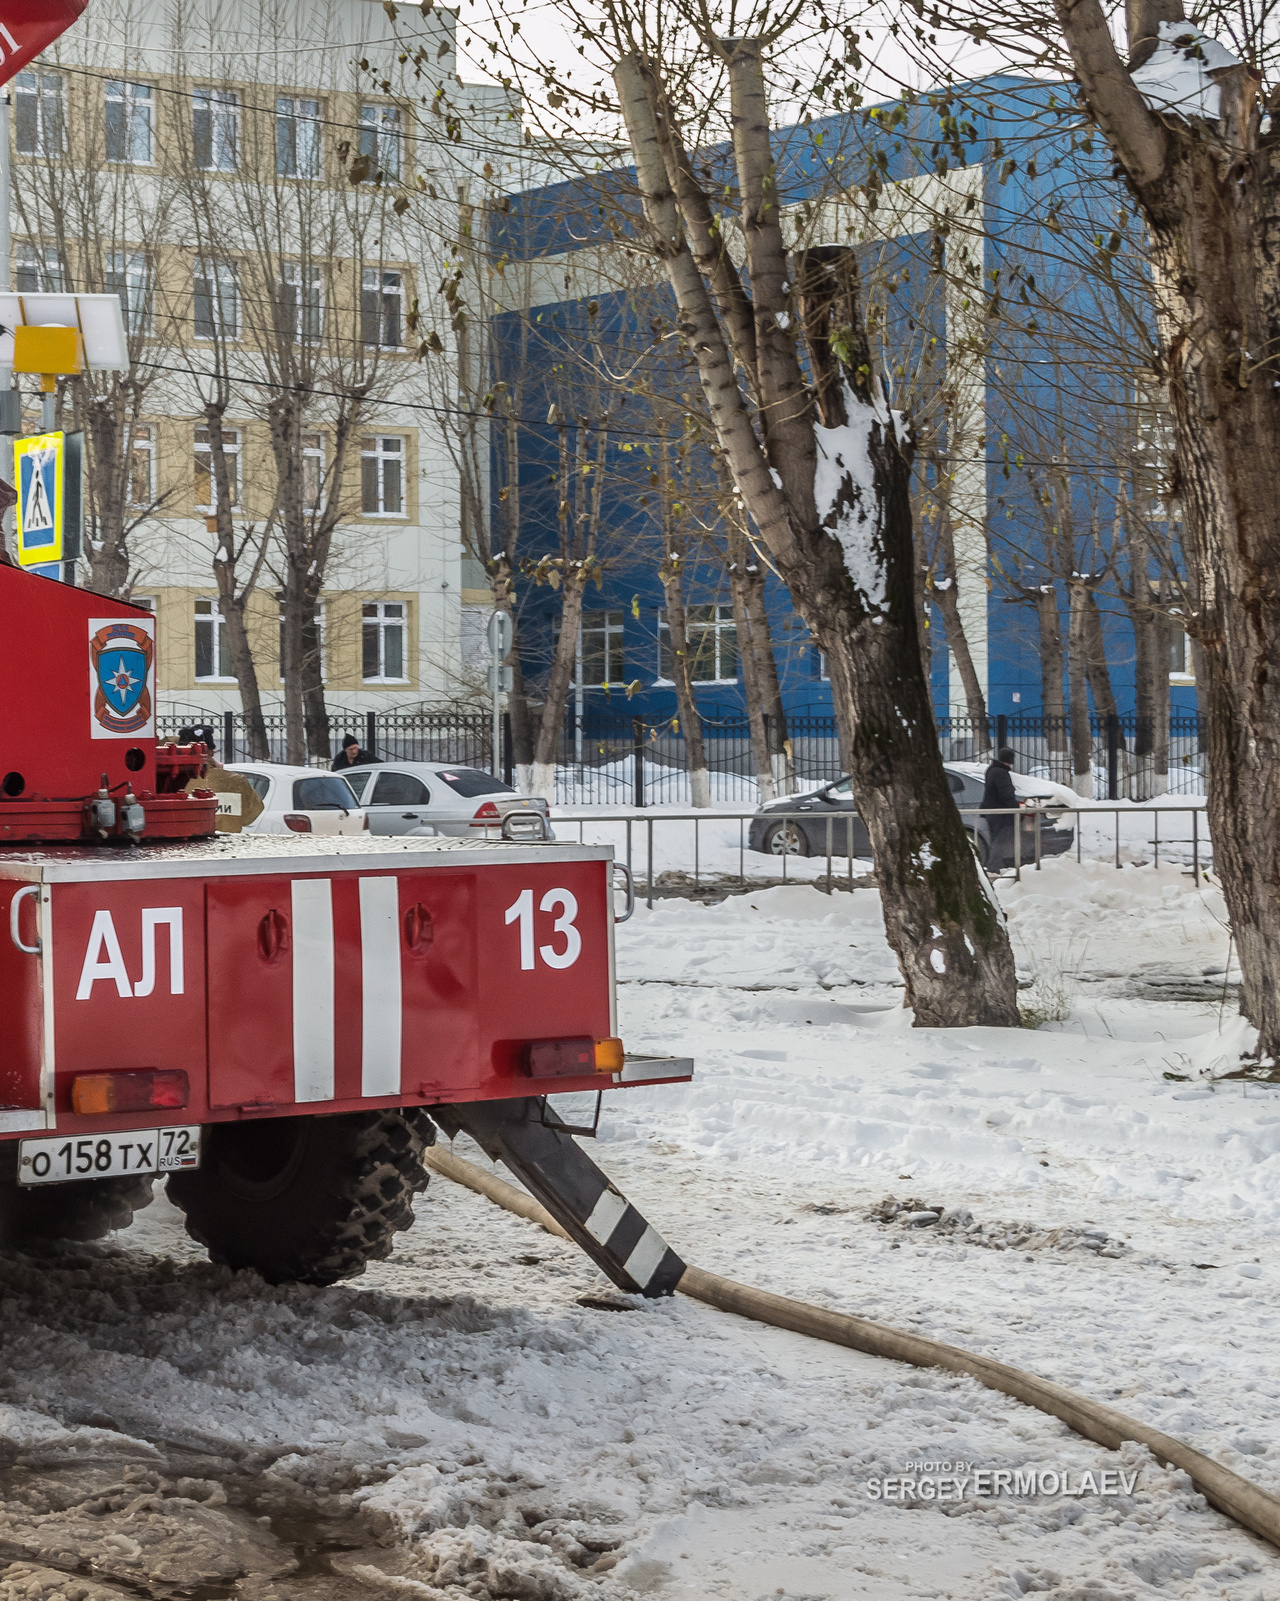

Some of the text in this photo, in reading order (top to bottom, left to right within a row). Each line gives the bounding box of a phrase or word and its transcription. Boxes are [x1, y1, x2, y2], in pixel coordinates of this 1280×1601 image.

[504, 887, 583, 971] 13
[76, 906, 185, 1001] АЛ
[58, 1139, 112, 1174] 158
[163, 1130, 190, 1156] 72
[160, 1156, 180, 1167] RUS
